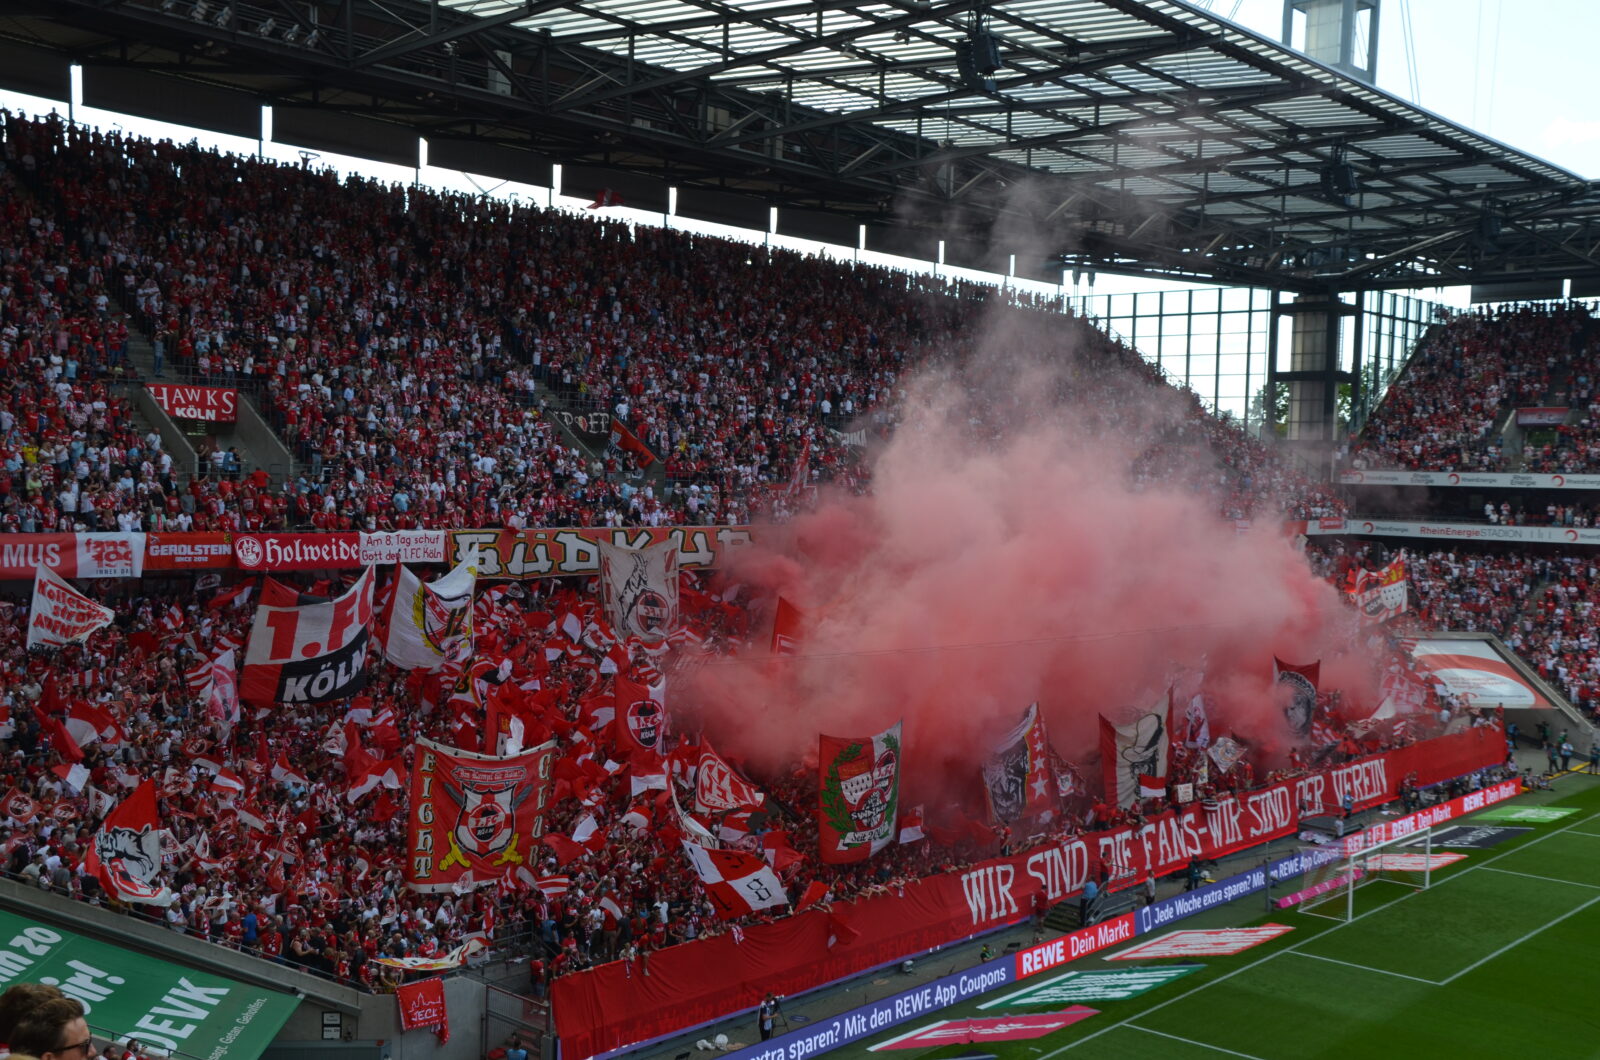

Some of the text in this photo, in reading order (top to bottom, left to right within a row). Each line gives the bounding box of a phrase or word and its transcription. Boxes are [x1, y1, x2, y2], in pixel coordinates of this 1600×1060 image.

[148, 387, 235, 414] HAWKS
[175, 405, 217, 420] KÖLN
[366, 532, 440, 547] Am 8. Tag schuf
[1420, 526, 1522, 538] RheinEnergieSTADION
[149, 544, 232, 556] GEROLSTEIN
[265, 538, 360, 567] Holweide
[361, 550, 382, 561] Gott
[423, 547, 442, 559] Köln
[283, 640, 367, 702] KÖLN
[1463, 790, 1485, 813] REWE
[1486, 787, 1499, 805] Dein
[1499, 782, 1516, 800] Markt
[413, 752, 438, 879] FIGHT
[1391, 815, 1415, 836] REWE
[1418, 812, 1431, 828] Dein
[1433, 805, 1452, 823] Markt
[961, 864, 1019, 926] WIR
[1026, 840, 1088, 908] SIND
[1098, 829, 1137, 881] DIE
[1248, 786, 1292, 838] SIND
[1295, 775, 1326, 819] DER
[1331, 758, 1388, 807] VEREIN
[1154, 906, 1174, 924] Jede
[1175, 895, 1202, 916] Woche
[1203, 889, 1223, 906] extra
[1224, 875, 1252, 901] sparen?
[1252, 870, 1266, 889] Mit
[1279, 858, 1300, 879] REWE
[1300, 855, 1313, 873] App
[8, 927, 63, 956] 20
[1022, 941, 1065, 975] REWE
[1070, 932, 1096, 958] Dein
[1097, 919, 1130, 948] Markt
[119, 976, 231, 1058] DEVK
[219, 1025, 245, 1045] Getan.
[236, 997, 268, 1025] Geholfen.
[788, 1021, 841, 1060] sparen?
[844, 1013, 867, 1039] Mit
[870, 1007, 892, 1026] den
[895, 988, 932, 1020] REWE
[935, 985, 957, 1007] App
[960, 967, 1006, 995] Coupons
